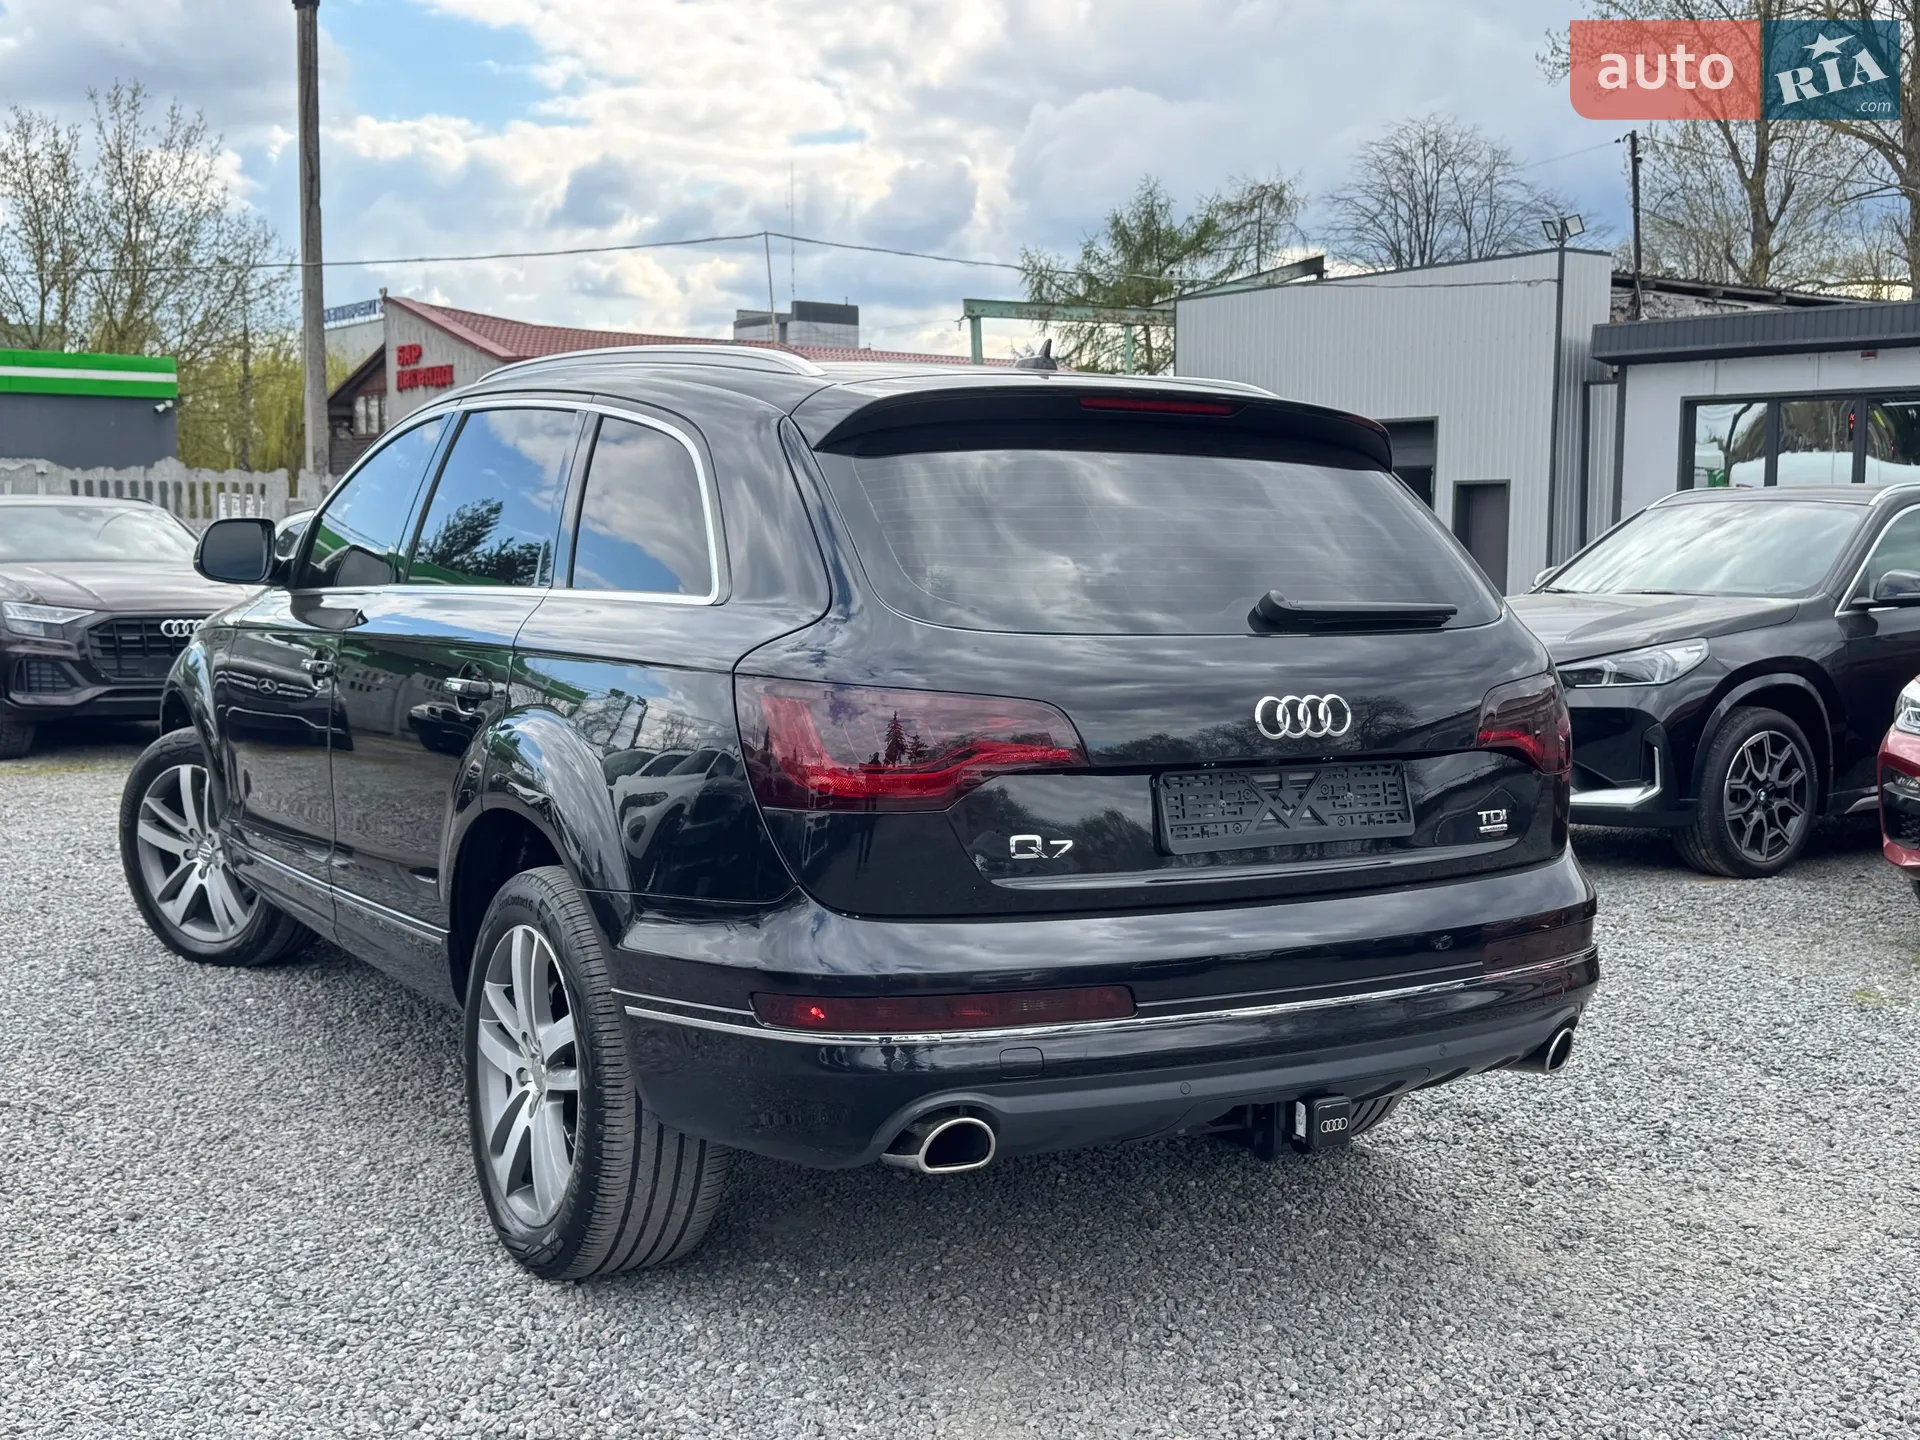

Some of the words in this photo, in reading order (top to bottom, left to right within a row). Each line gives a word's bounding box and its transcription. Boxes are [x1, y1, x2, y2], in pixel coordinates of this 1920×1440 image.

[396, 344, 422, 366] БАР
[1477, 809, 1507, 825] TDI
[1009, 834, 1074, 859] Q7
